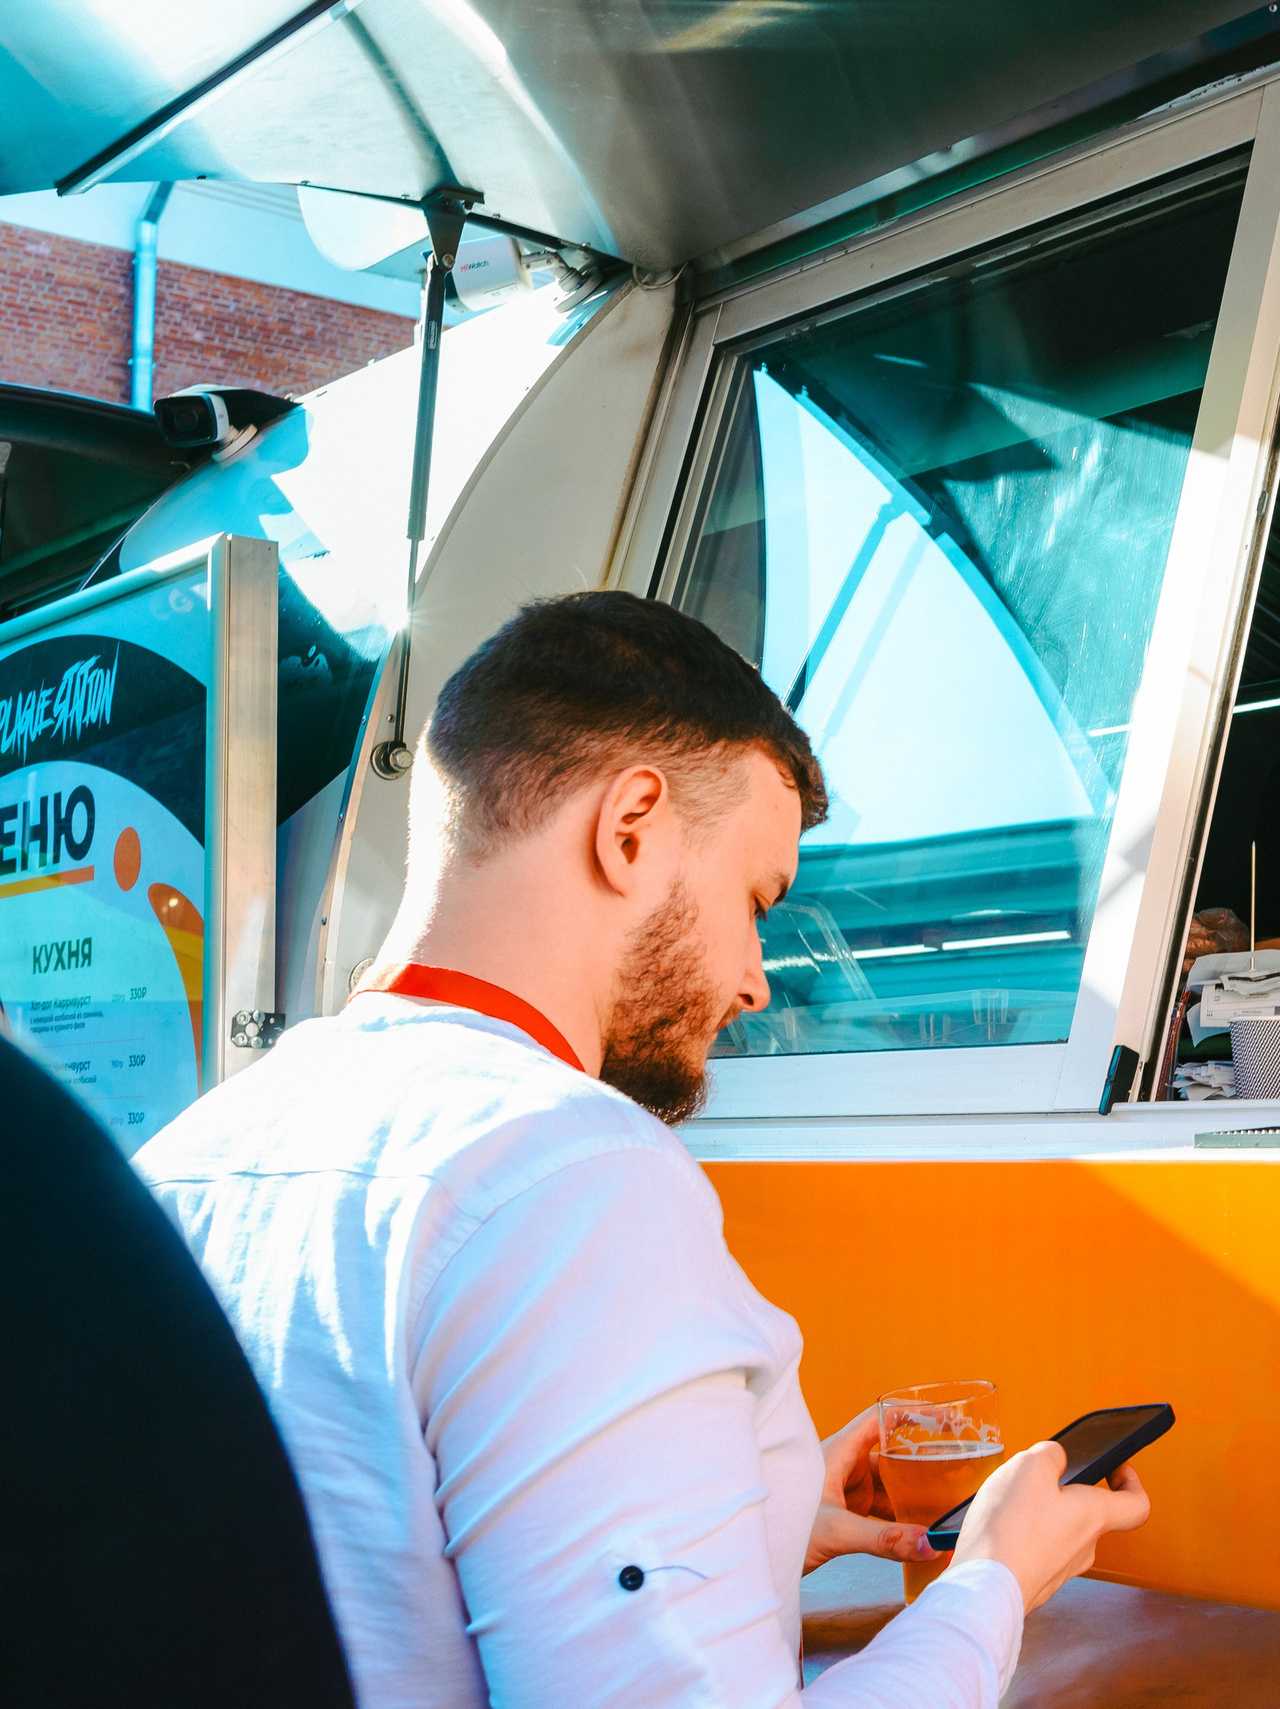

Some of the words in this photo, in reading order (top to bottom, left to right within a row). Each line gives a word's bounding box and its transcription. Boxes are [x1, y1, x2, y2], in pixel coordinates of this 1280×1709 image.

[460, 260, 489, 272] HiWatch
[50, 640, 120, 745] STATION
[0, 785, 95, 876] ЕНЮ
[32, 937, 92, 975] КУХНЯ
